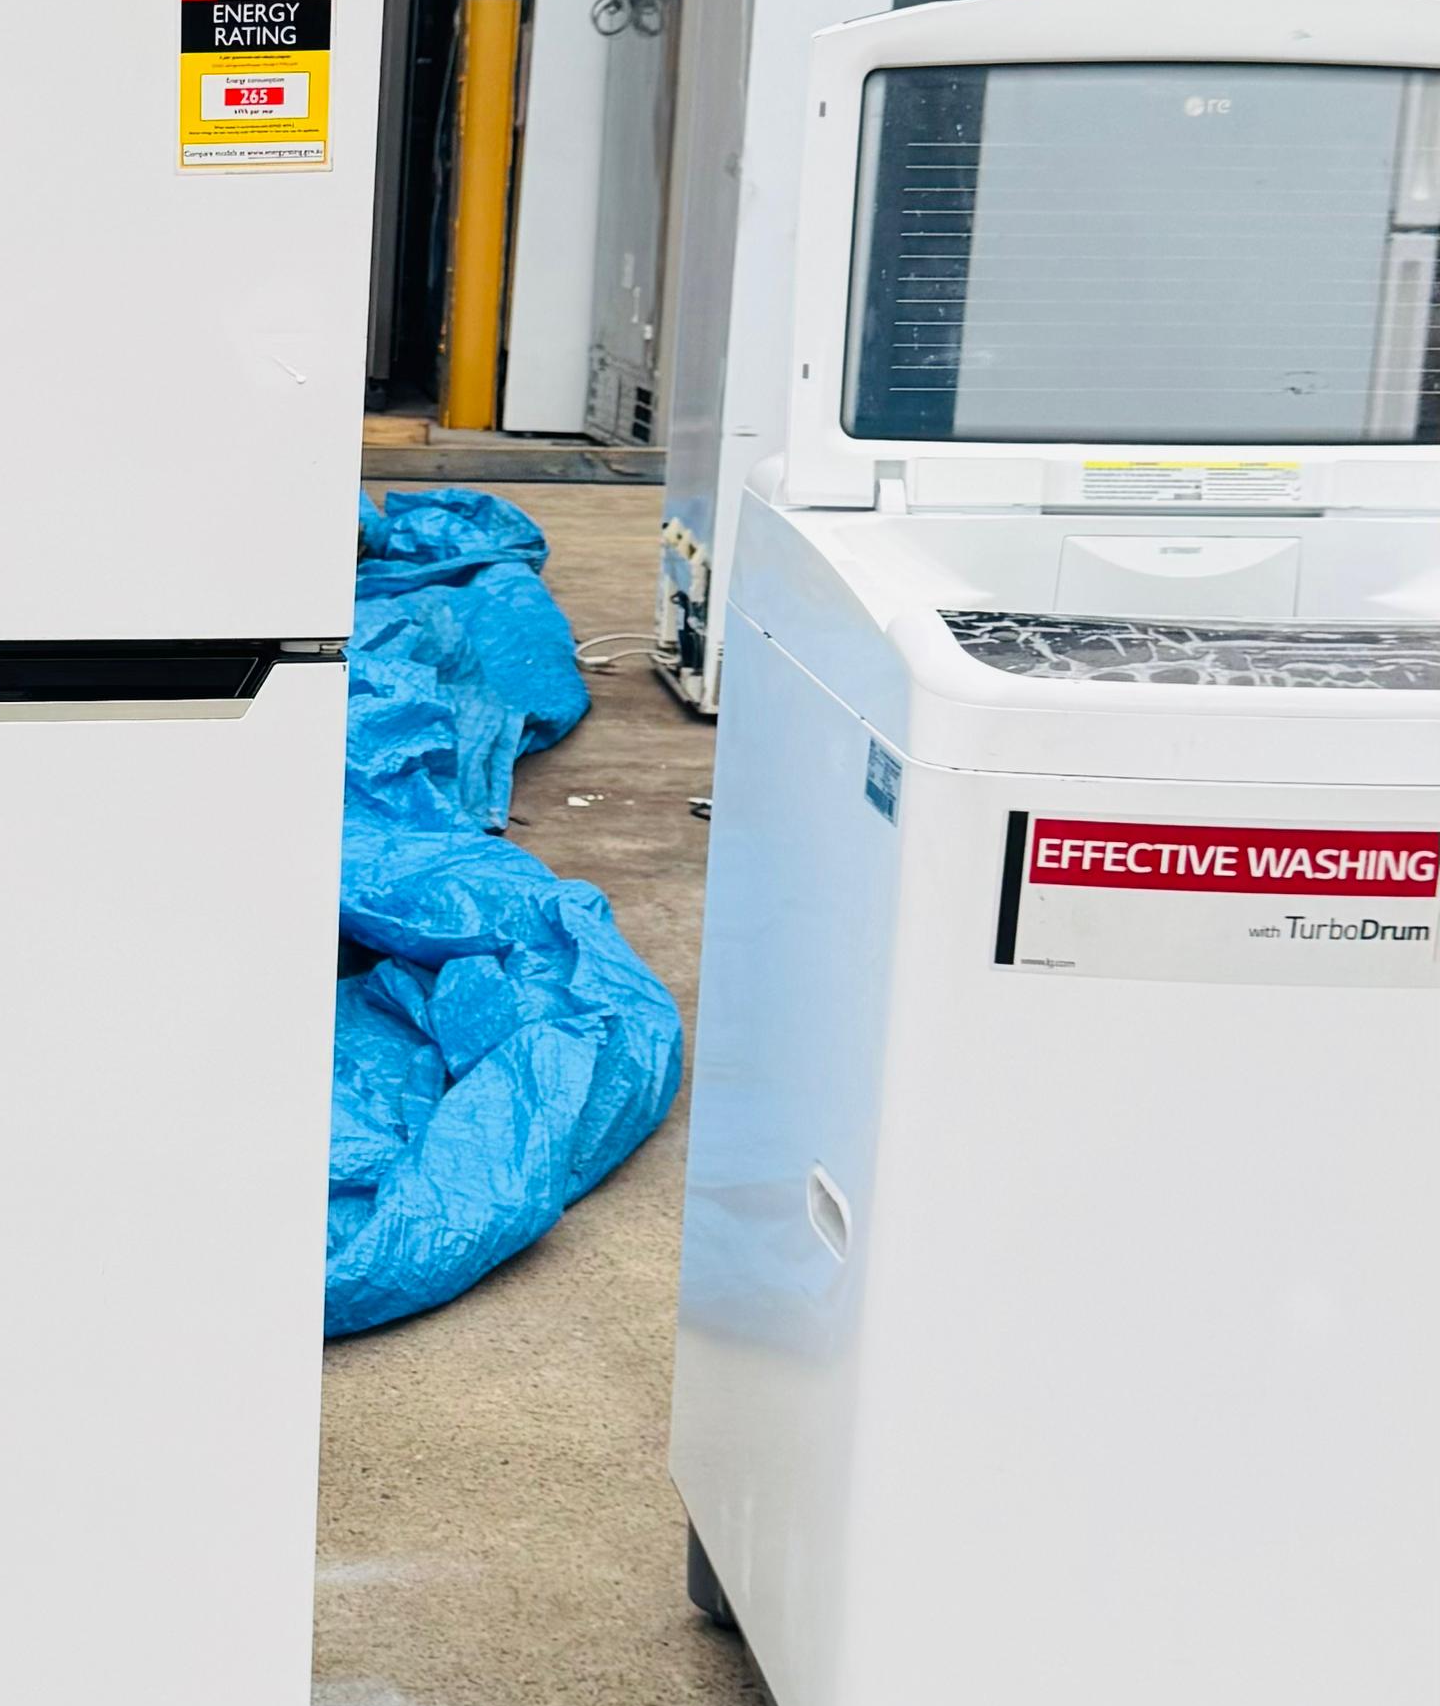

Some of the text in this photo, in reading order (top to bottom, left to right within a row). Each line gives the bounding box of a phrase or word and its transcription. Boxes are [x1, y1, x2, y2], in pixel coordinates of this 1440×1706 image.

[213, 2, 300, 24] ENERGY
[214, 26, 297, 47] RATING
[240, 89, 268, 105] 265
[1035, 837, 1438, 882] EFFECTIVE WASHING
[1248, 915, 1431, 941] with TurboDrum
